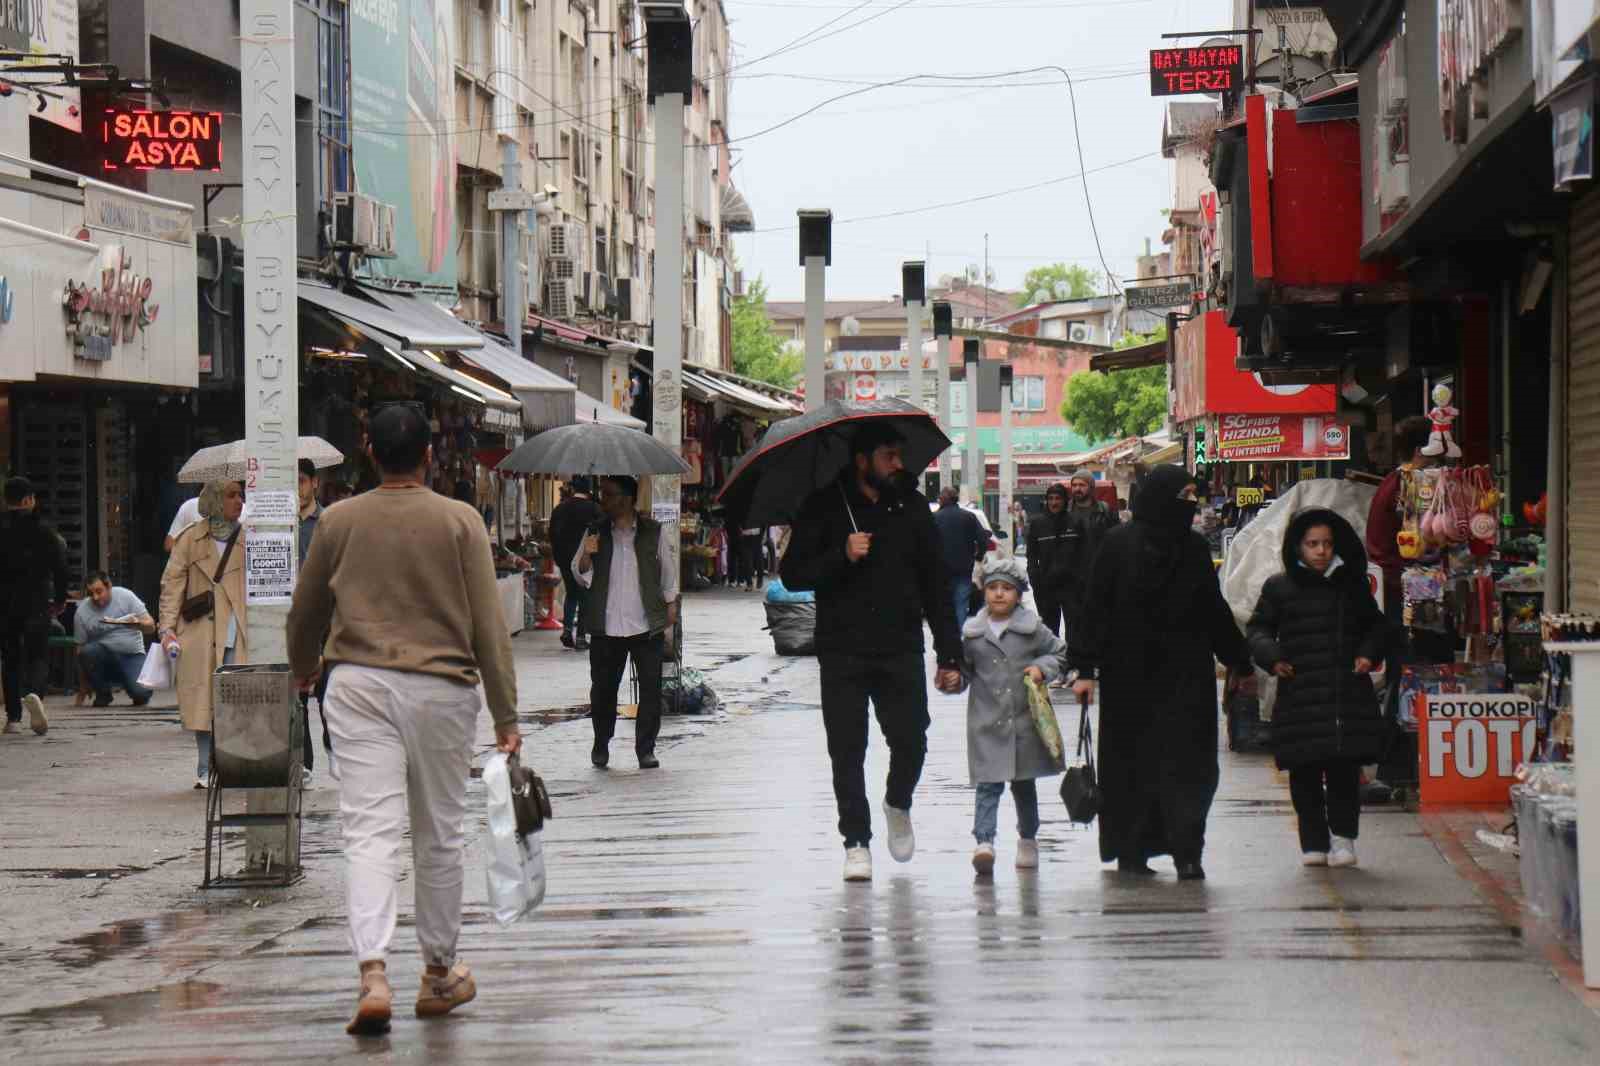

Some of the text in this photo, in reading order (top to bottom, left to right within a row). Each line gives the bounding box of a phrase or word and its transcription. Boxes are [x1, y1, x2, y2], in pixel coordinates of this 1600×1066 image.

[115, 114, 210, 139] SALON
[251, 14, 282, 233] SAKARYA
[125, 142, 200, 165] ASYA
[1223, 425, 1281, 441] HIZINDA
[1239, 493, 1261, 505] 300
